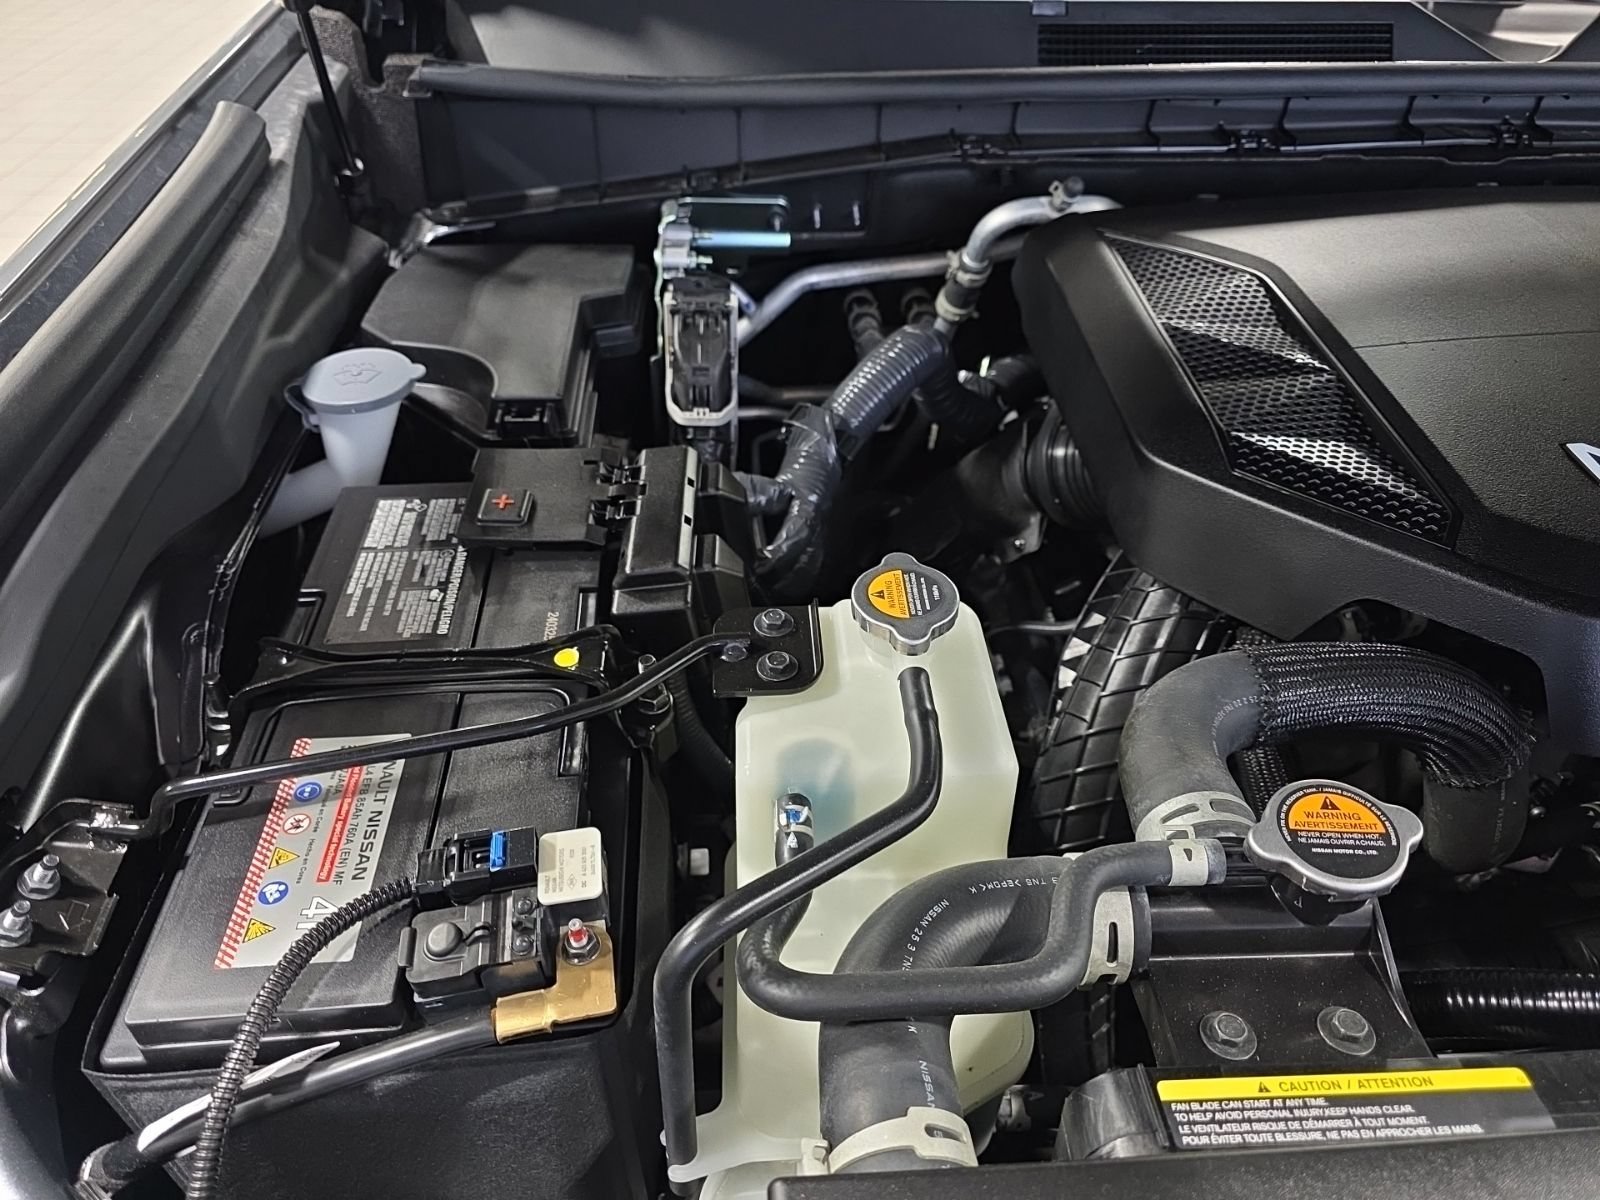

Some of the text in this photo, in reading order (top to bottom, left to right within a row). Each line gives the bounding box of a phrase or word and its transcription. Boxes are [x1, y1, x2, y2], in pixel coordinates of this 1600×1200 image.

[885, 580, 896, 608] WARNING
[894, 574, 907, 616] AVERTISSEMENT
[360, 778, 372, 796] EFB
[352, 798, 366, 820] 85Ah
[1304, 811, 1361, 820] WARNING
[351, 761, 396, 880] NAULT NISSAN
[1294, 820, 1378, 830] AVERTISSEMENT
[344, 822, 359, 845] 760A
[319, 843, 338, 880] technology
[335, 848, 352, 868] (EN)
[333, 872, 344, 886] MF
[920, 899, 950, 927] NISSAN
[1278, 1076, 1434, 1092] CAUTION / ATTENTION
[1171, 1097, 1328, 1111] FAN BLADE CAN START AT ANY TIME.
[1174, 1112, 1188, 1122] TO
[1190, 1112, 1213, 1121] HELP
[1215, 1111, 1242, 1120] AVOID
[1244, 1109, 1293, 1119] PERSONAL
[1349, 1106, 1382, 1115] HANDS
[1383, 1105, 1415, 1114] CLEAR.
[1179, 1116, 1430, 1134] LE VENTILATEUR RISQUE DE DÉMARRER À TOUT MOMENT.
[1182, 1124, 1484, 1145] POUR ÉVITER TOUTE BLESSURE, NE PAS EN APPROCHER LES MAINS.
